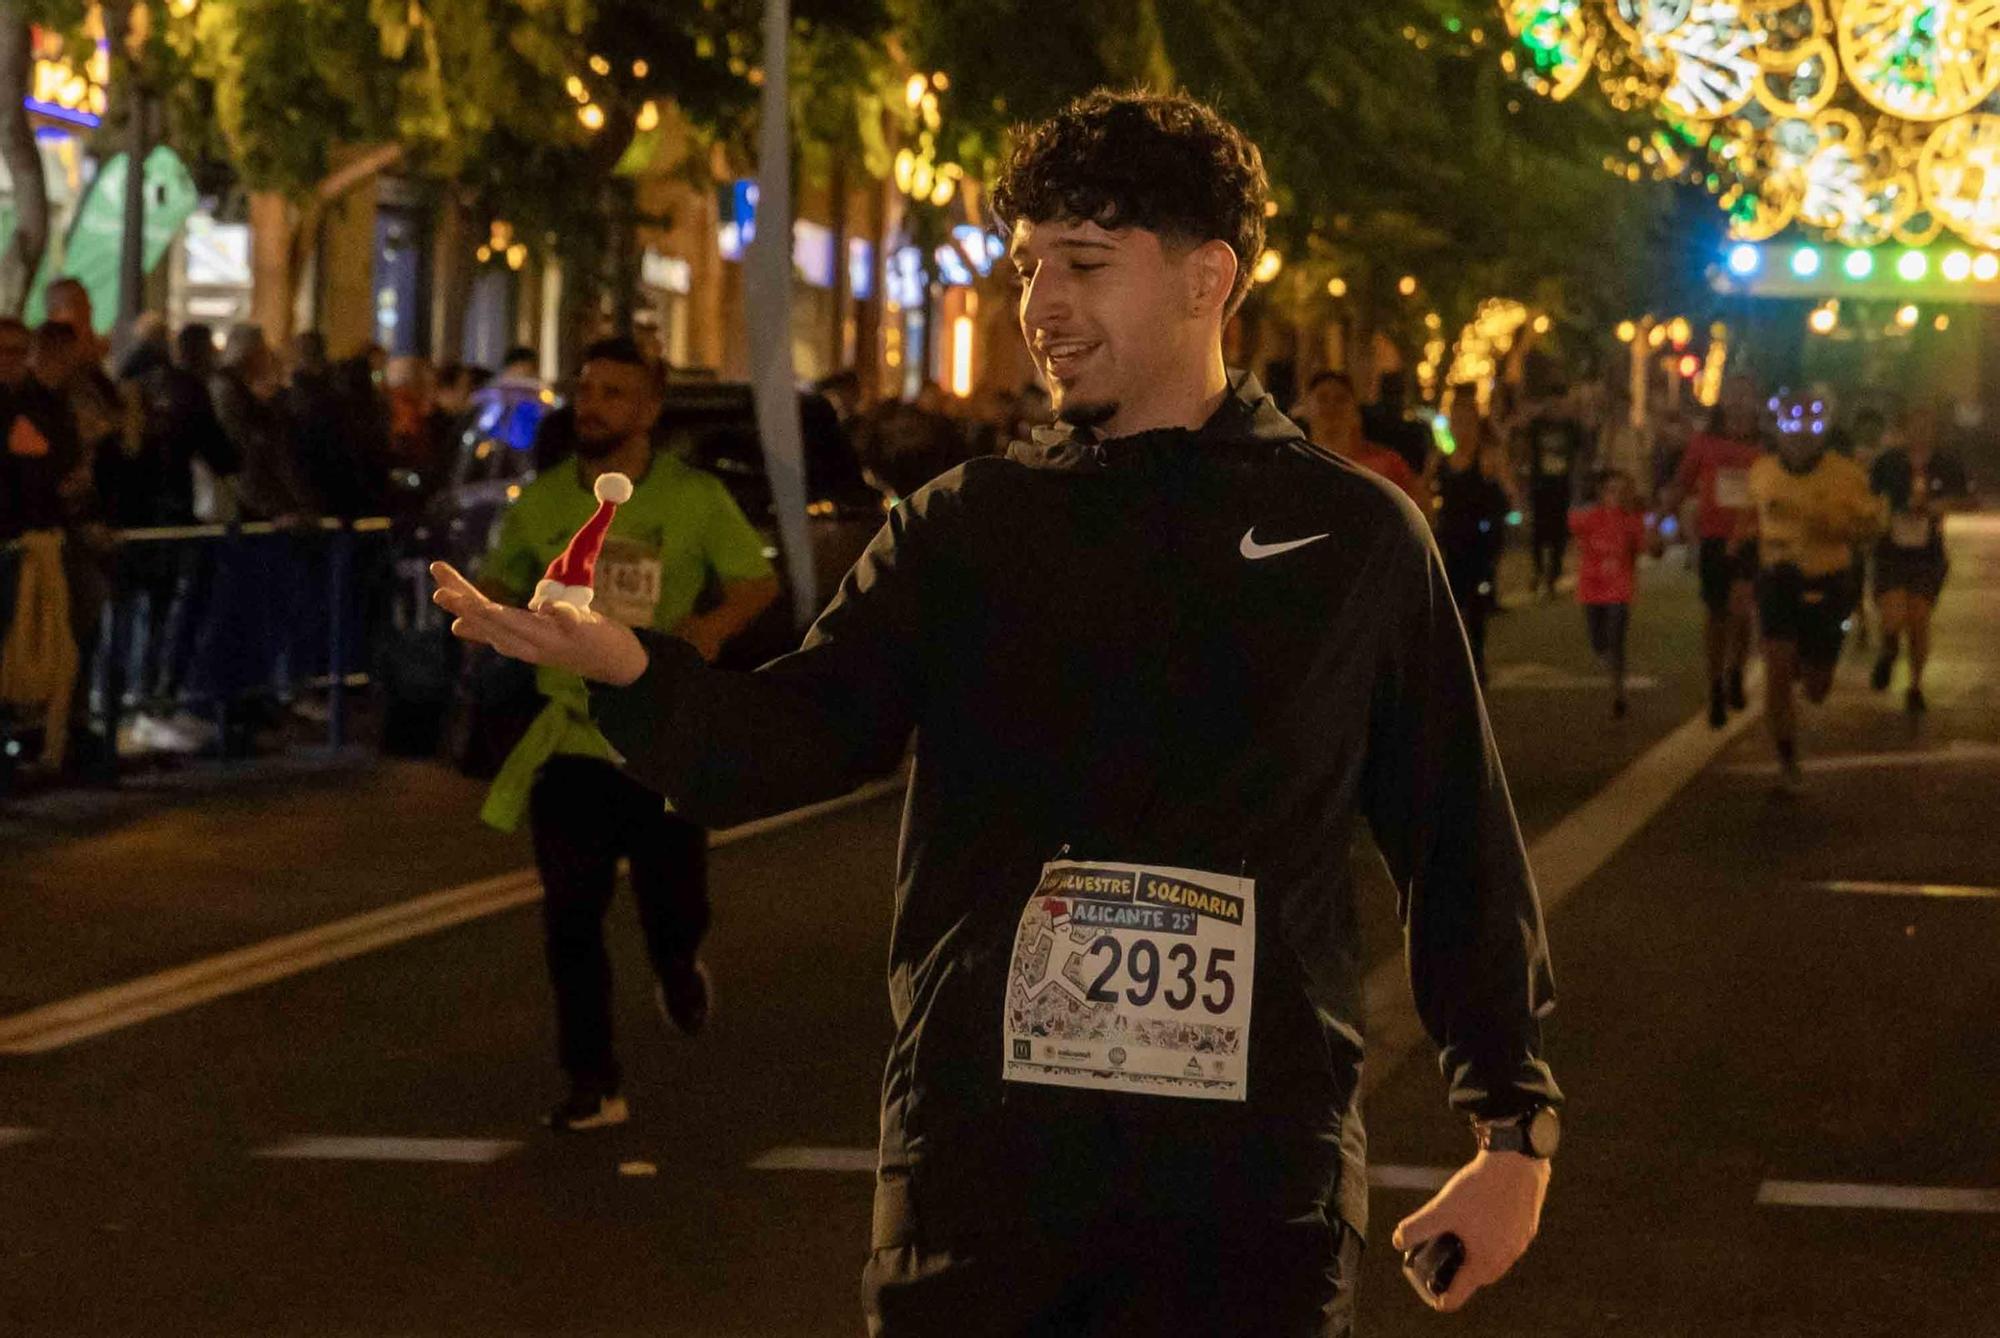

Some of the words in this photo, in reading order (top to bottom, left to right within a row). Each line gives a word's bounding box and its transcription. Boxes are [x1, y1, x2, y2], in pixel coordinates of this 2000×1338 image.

[1073, 903, 1164, 928] ALICANTE
[1147, 880, 1239, 919] SOLIDARIA
[1086, 935, 1236, 1015] 2935
